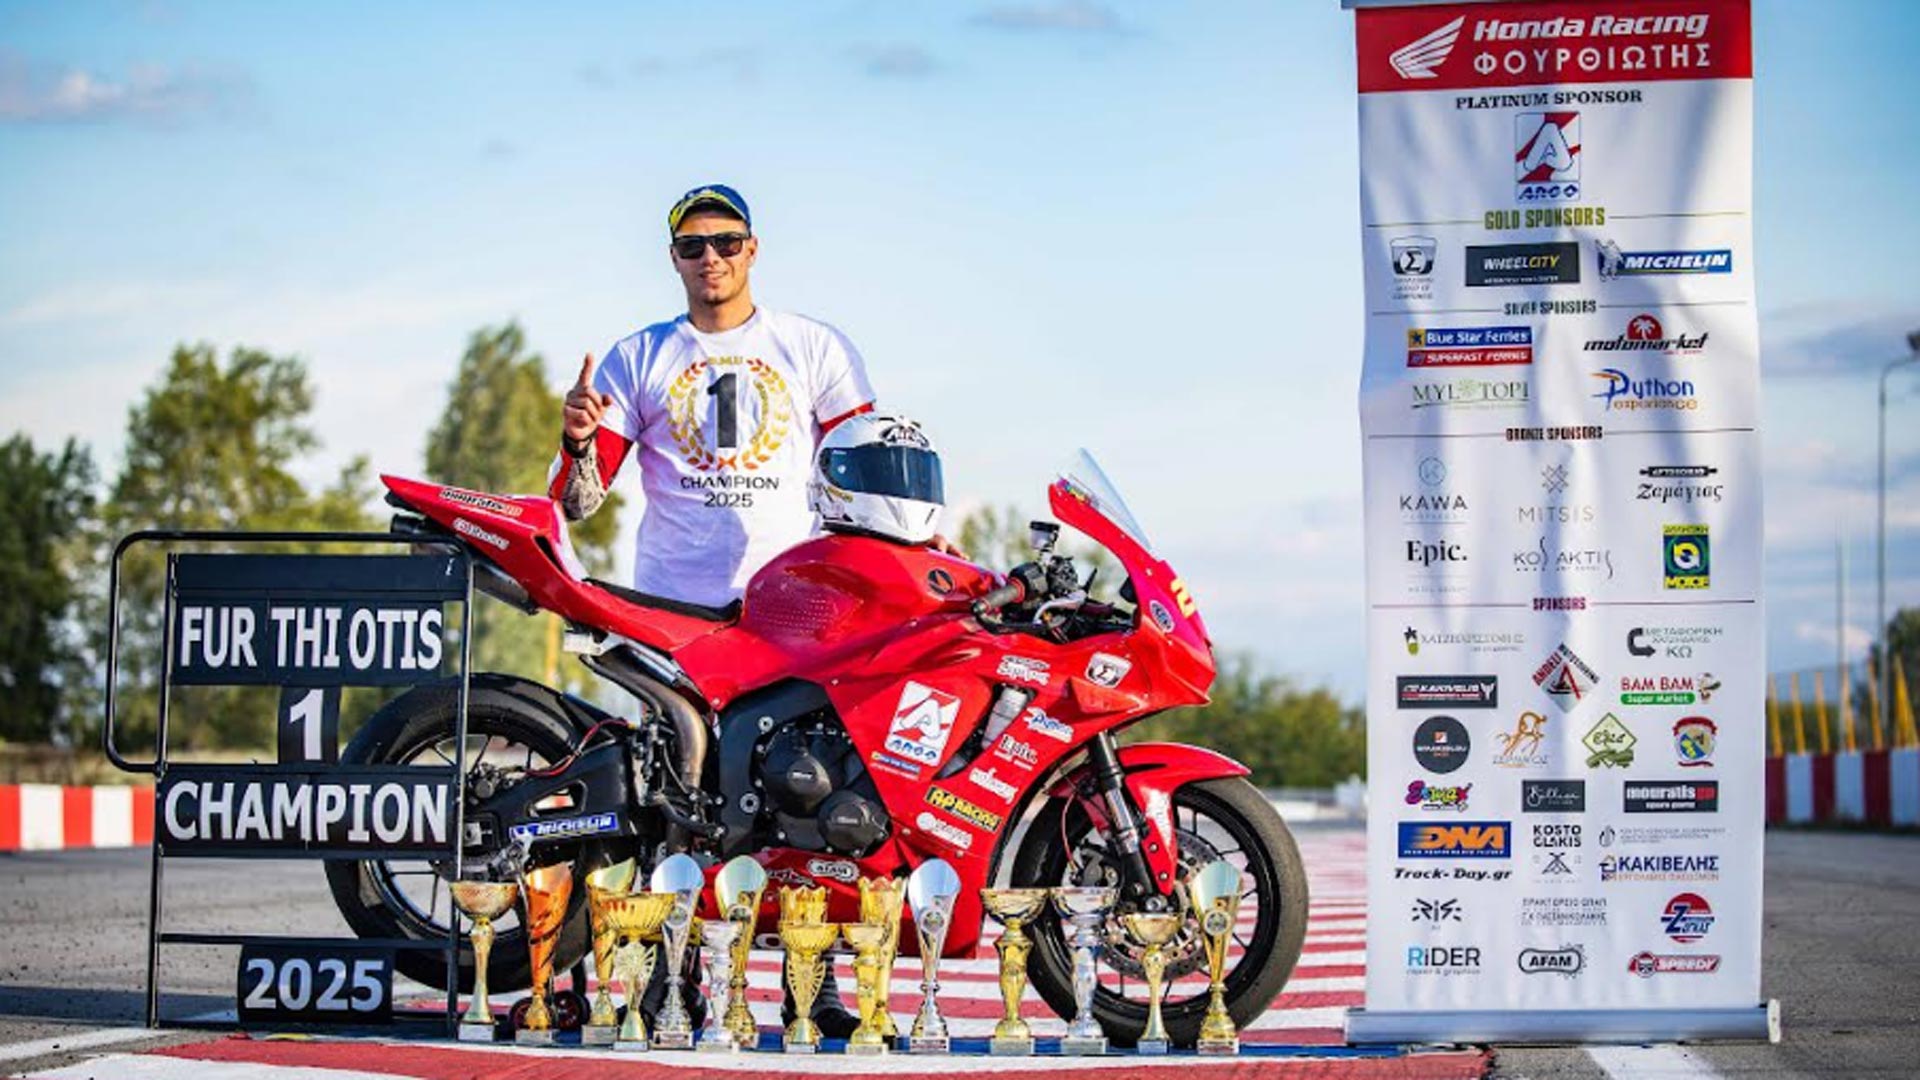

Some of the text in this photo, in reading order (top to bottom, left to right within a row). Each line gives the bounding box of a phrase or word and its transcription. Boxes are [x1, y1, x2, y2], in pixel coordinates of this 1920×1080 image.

[1473, 14, 1709, 41] Honda Racing
[1473, 43, 1711, 75] ΦΟΥΡΘΙΩΤΗΣ
[1456, 89, 1643, 111] PLATINUM SPONSOR
[1484, 207, 1605, 231] GOLD SPONSORS
[1624, 253, 1729, 269] MICHELIN
[1504, 299, 1597, 316] SILVER SPONSORS
[1426, 329, 1529, 344] Blue Star Ferries
[1583, 331, 1709, 351] motomarket
[1426, 351, 1529, 364] SUPERFAST FERRIES
[1593, 368, 1695, 410] Python
[706, 372, 738, 448] 1
[1613, 398, 1698, 411] experience
[1505, 425, 1603, 442] BRONZE SPONSORS
[680, 475, 780, 491] CHAMPION
[704, 492, 754, 508] 2025
[1400, 495, 1468, 511] KAWA
[1518, 505, 1595, 523] MITSIS
[1406, 540, 1467, 567] Epic.
[1533, 597, 1586, 611] SPONSORS
[1621, 676, 1694, 691] BAM BAM
[289, 688, 324, 761] 1
[164, 780, 447, 844] CHAMPION
[536, 816, 612, 835] MICHELIN
[1533, 825, 1581, 835] KOSTO
[1413, 825, 1504, 850] DNA
[1619, 856, 1719, 872] ΚΑΚΙΒΕΛΗΣ
[1529, 955, 1572, 967] AFAM
[244, 957, 385, 1012] 2025
